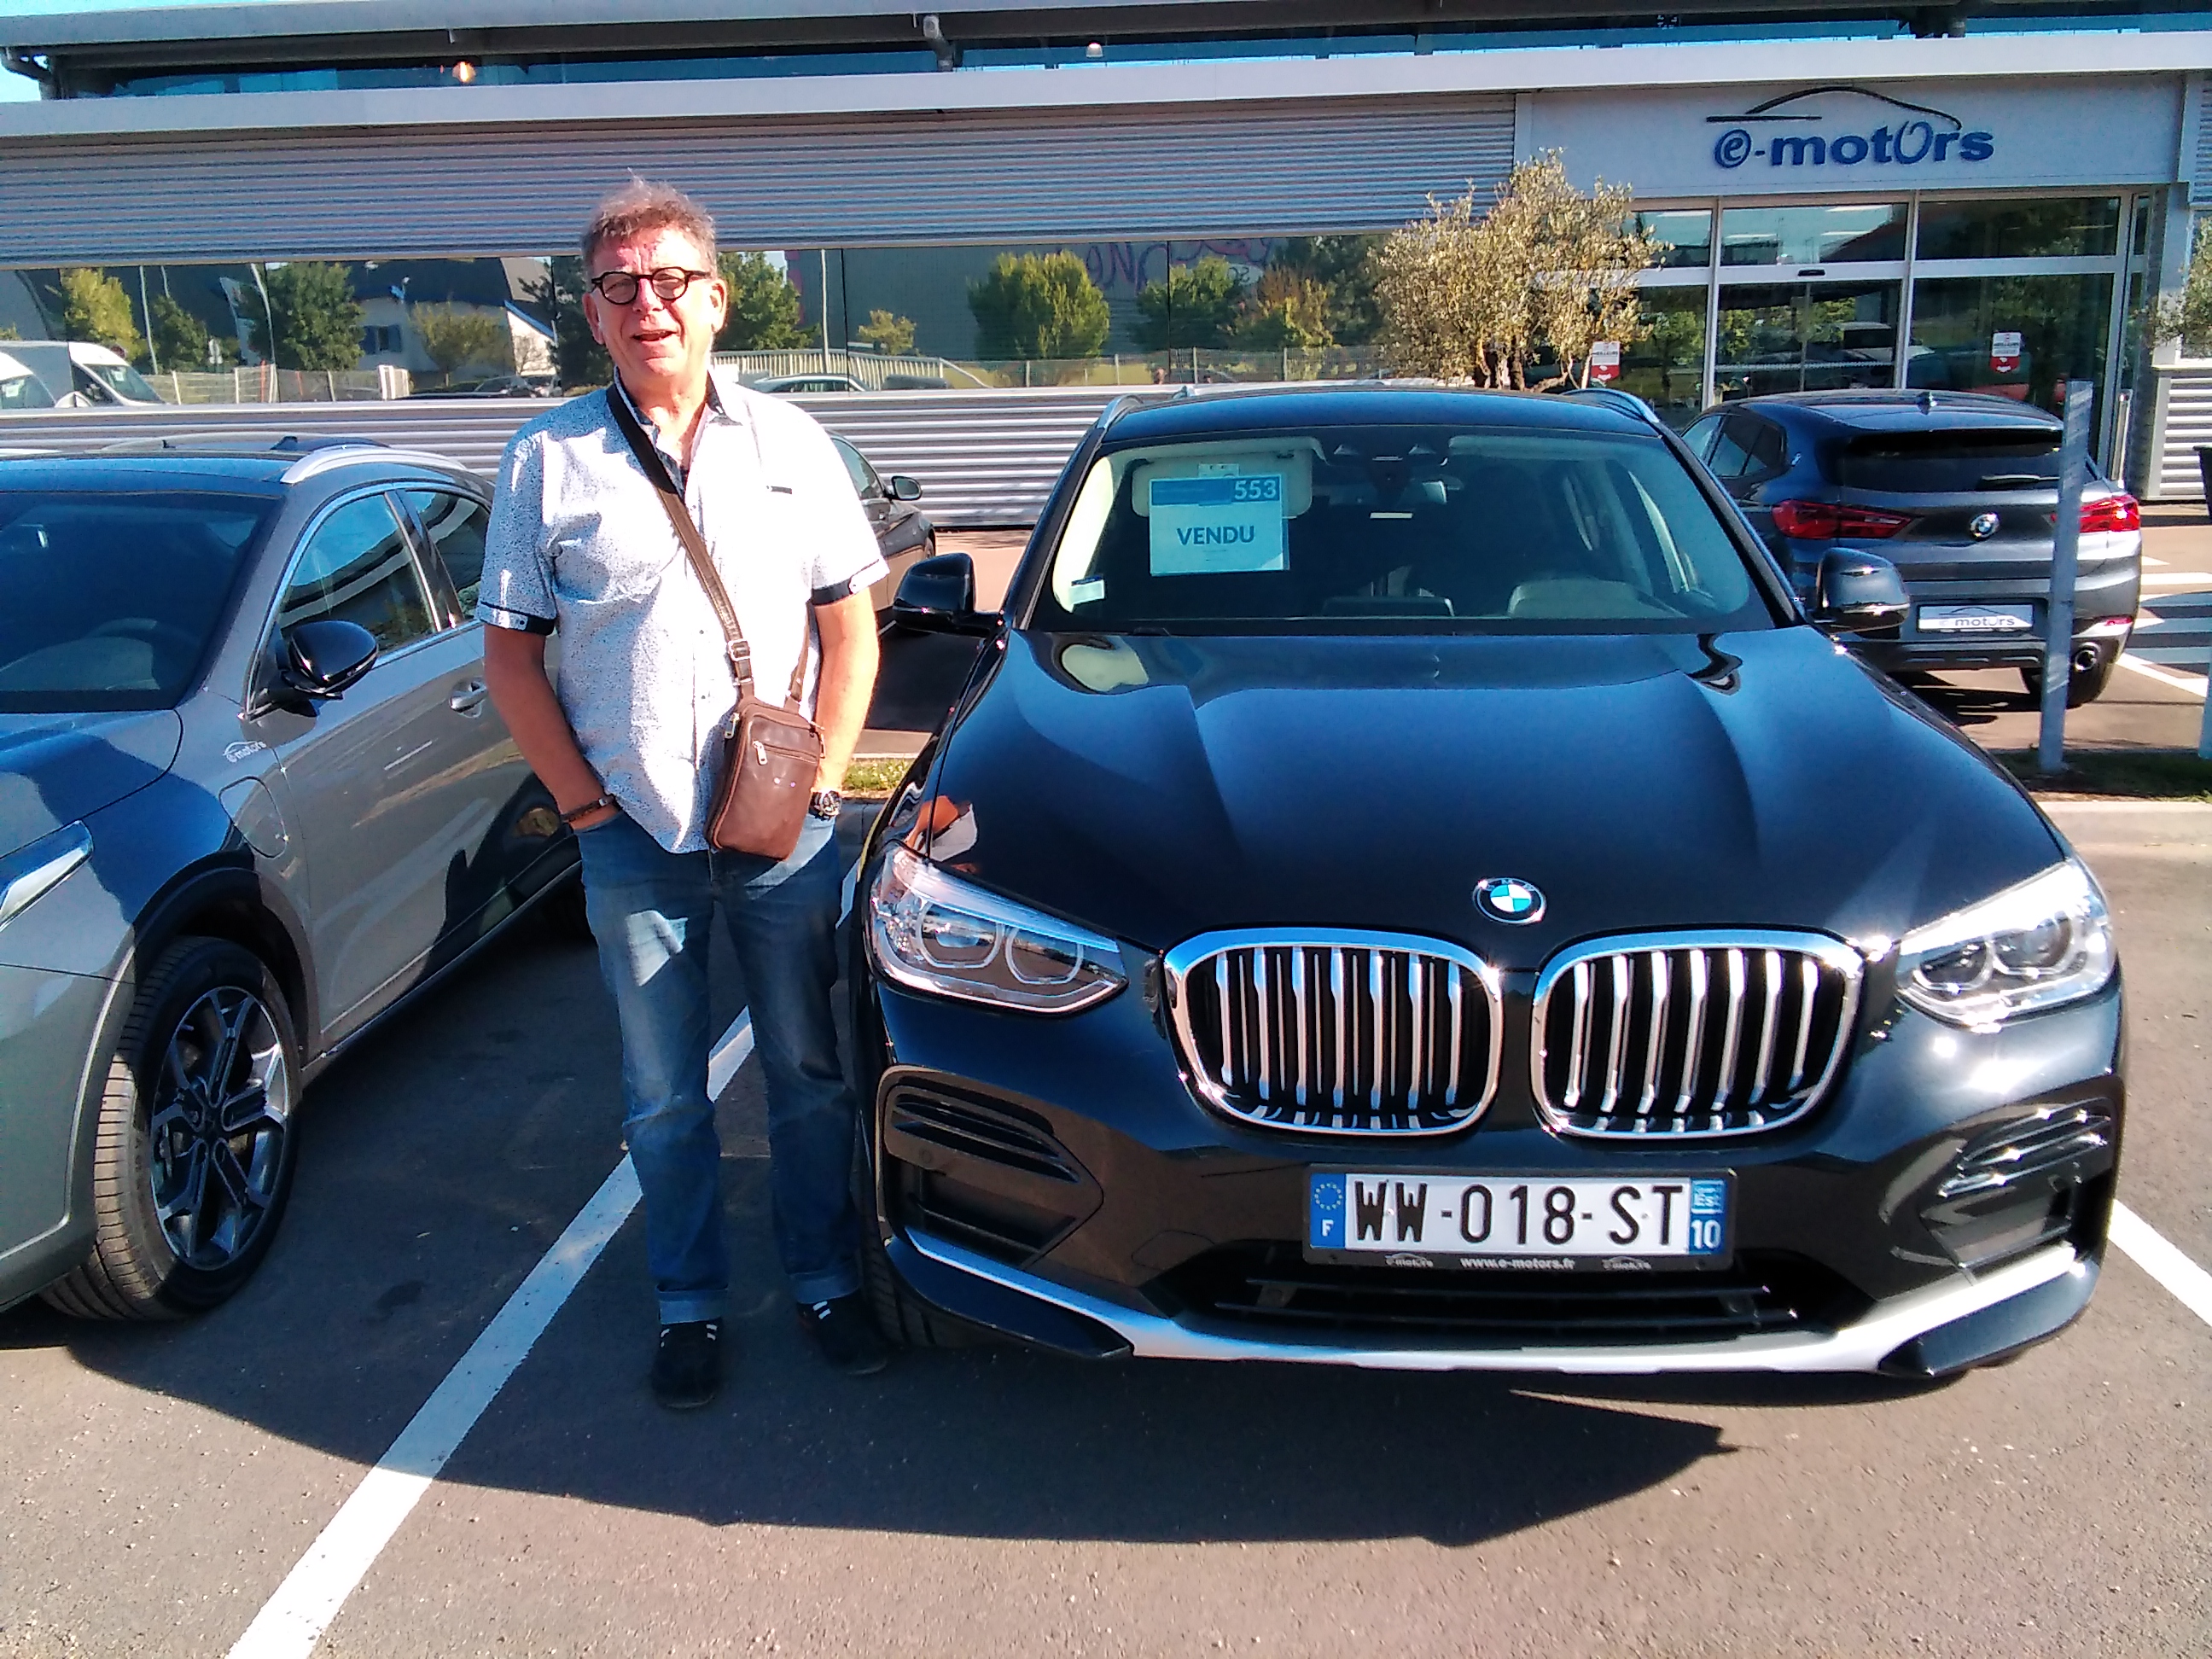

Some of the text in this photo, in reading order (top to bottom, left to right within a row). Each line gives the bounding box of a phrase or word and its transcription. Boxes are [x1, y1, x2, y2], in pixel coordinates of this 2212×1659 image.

[1235, 480, 1277, 499] 553
[1177, 526, 1254, 545] VENDU
[226, 741, 267, 763] emotors
[1354, 1180, 1683, 1246] WW-018-ST
[1322, 1219, 1334, 1237] F
[1691, 1220, 1720, 1249] 10
[1460, 1257, 1575, 1270] www.e-motors.fr
